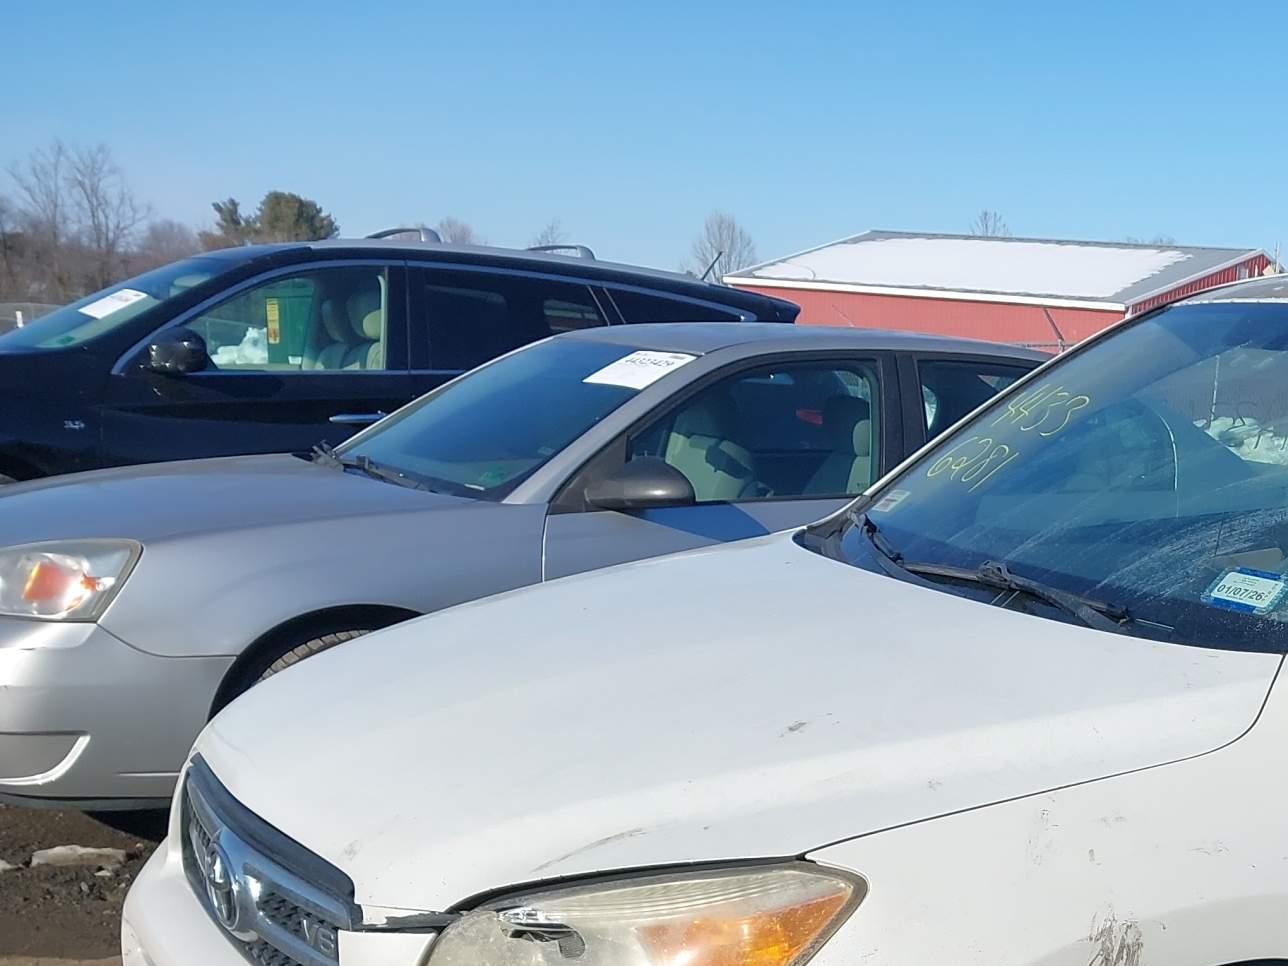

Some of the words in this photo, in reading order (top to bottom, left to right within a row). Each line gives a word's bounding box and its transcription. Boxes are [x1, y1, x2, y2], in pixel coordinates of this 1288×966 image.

[926, 437, 1020, 493] 6281
[1216, 585, 1262, 601] 01/07/26
[302, 919, 335, 953] V6
